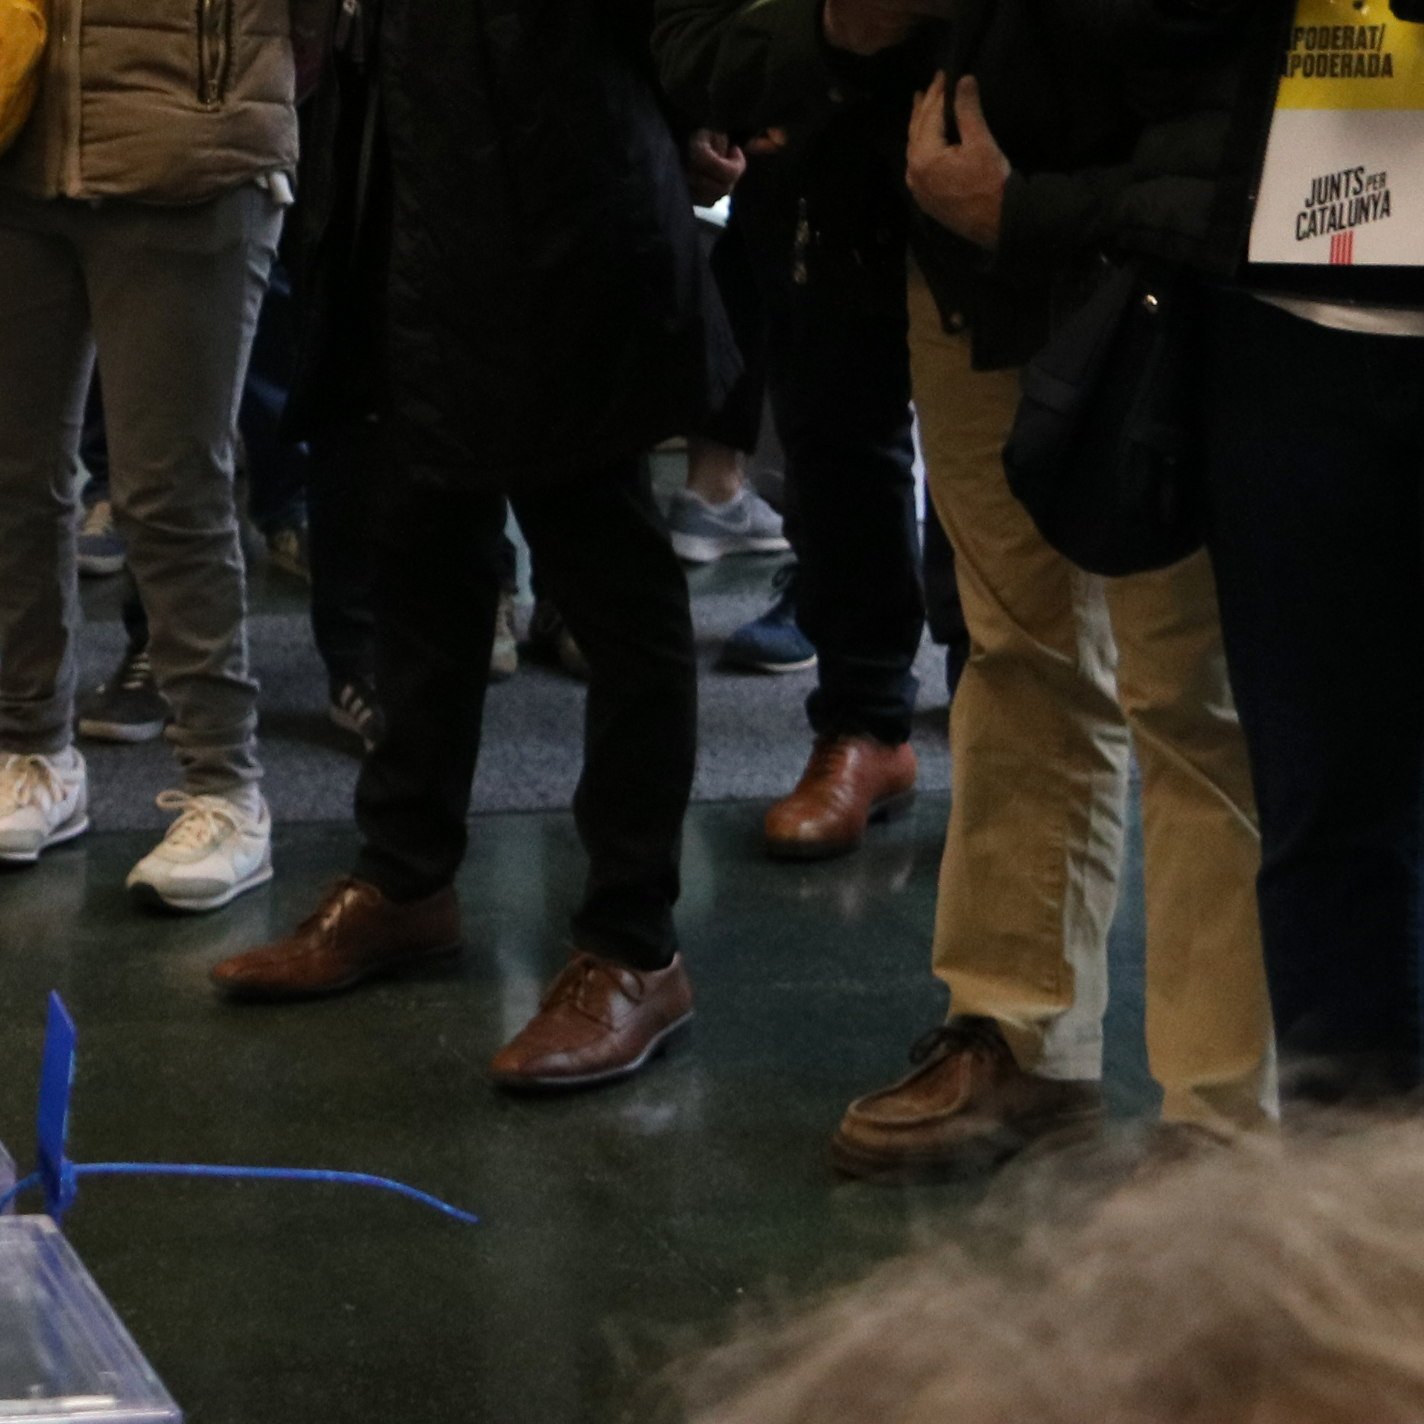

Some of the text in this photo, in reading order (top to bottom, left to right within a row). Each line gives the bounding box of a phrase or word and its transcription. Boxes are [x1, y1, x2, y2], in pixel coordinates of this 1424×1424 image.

[1290, 24, 1386, 51] PODERAT/
[1284, 53, 1393, 78] PODERADA
[1305, 166, 1388, 208] JUNTS PER
[1295, 189, 1392, 241] CATALUNYA
